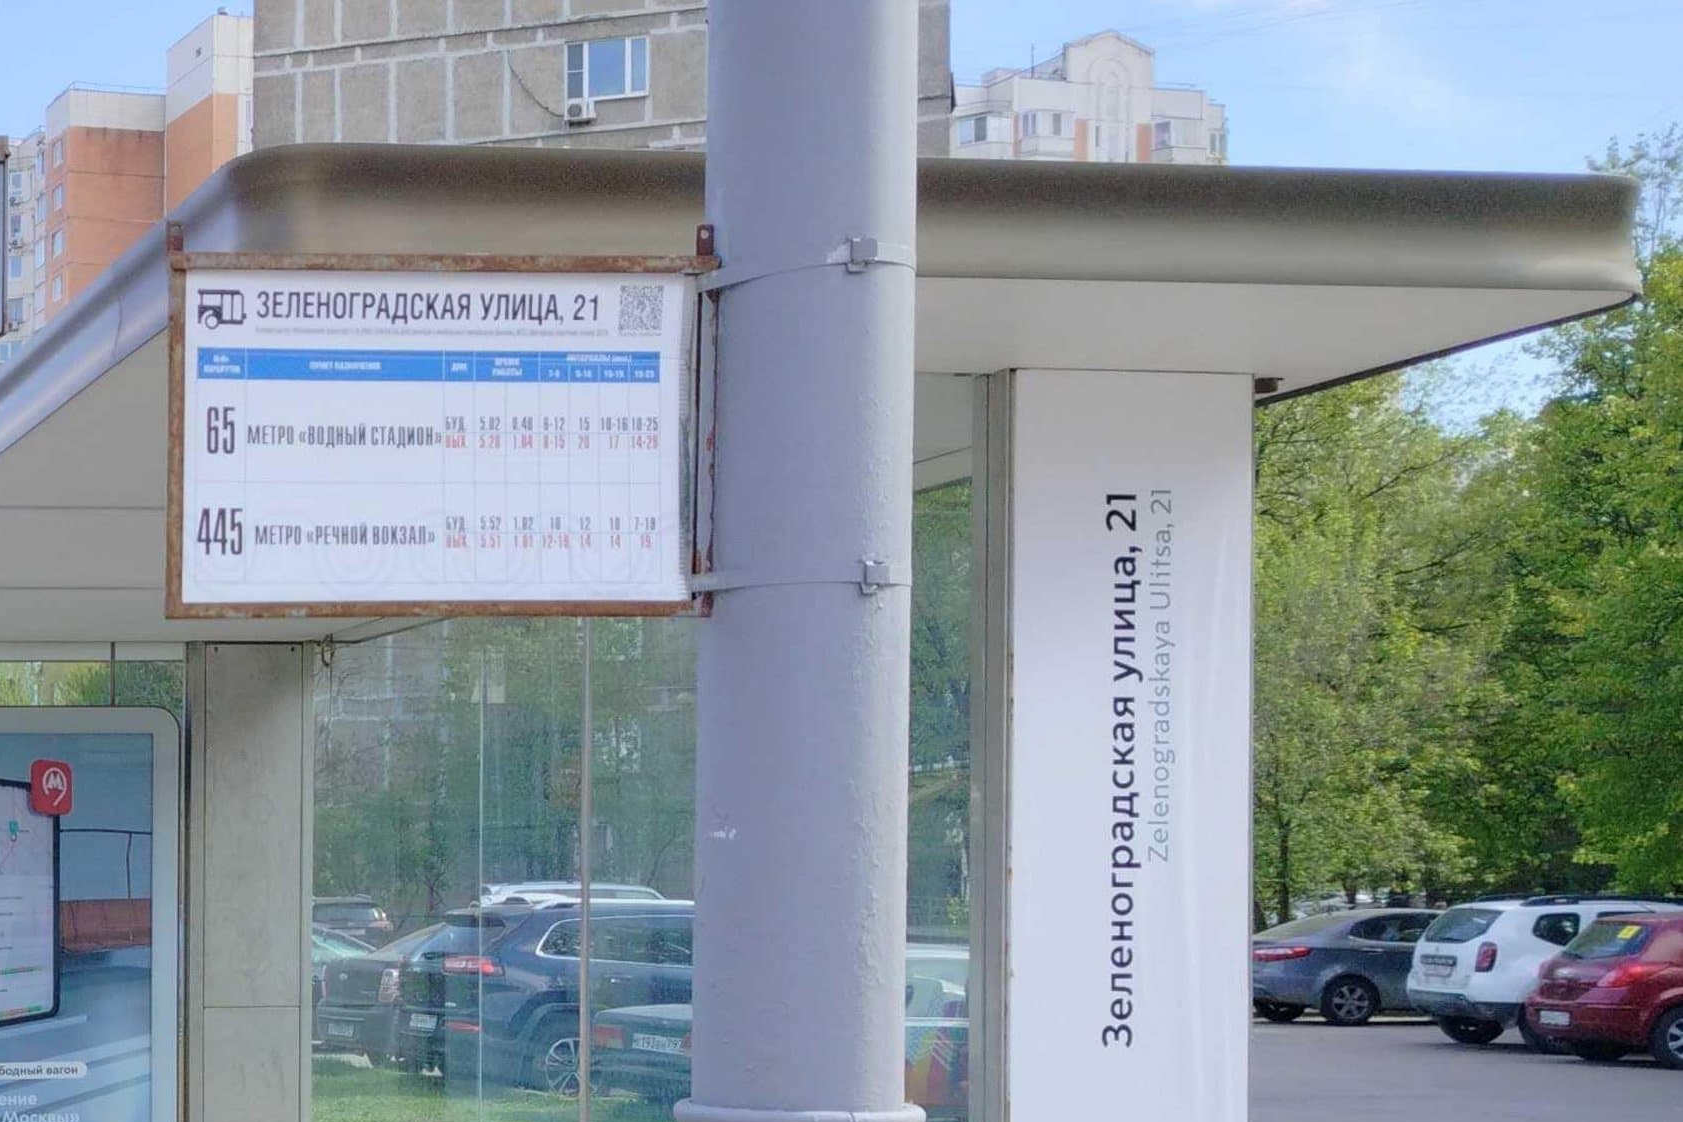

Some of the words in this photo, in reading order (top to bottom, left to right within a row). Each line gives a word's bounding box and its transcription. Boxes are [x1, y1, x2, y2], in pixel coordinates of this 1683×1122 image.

[256, 291, 471, 324] ЗЕЛЕНОГРАДСКАЯ
[480, 293, 564, 325] УЛИЦА,
[572, 294, 599, 321] 21
[206, 406, 235, 454] 65
[247, 425, 294, 445] МЕТРО
[298, 423, 366, 448] «ВОДНЫЙ
[371, 425, 442, 448] СТАДИОН»
[1105, 494, 1136, 532] 21
[1151, 489, 1172, 514] 21
[197, 508, 243, 555] 445
[254, 525, 302, 545] МЕТРО
[306, 522, 367, 545] «РЕЧНОЙ
[372, 525, 435, 545] ВОКЗАЛ»
[1149, 523, 1175, 610] Ulitsa,
[1112, 546, 1144, 682] улица,
[1146, 621, 1176, 863] Zelenogradskaya
[1102, 696, 1142, 1048] Зеленоградская
[46, 1066, 79, 1076] вагон
